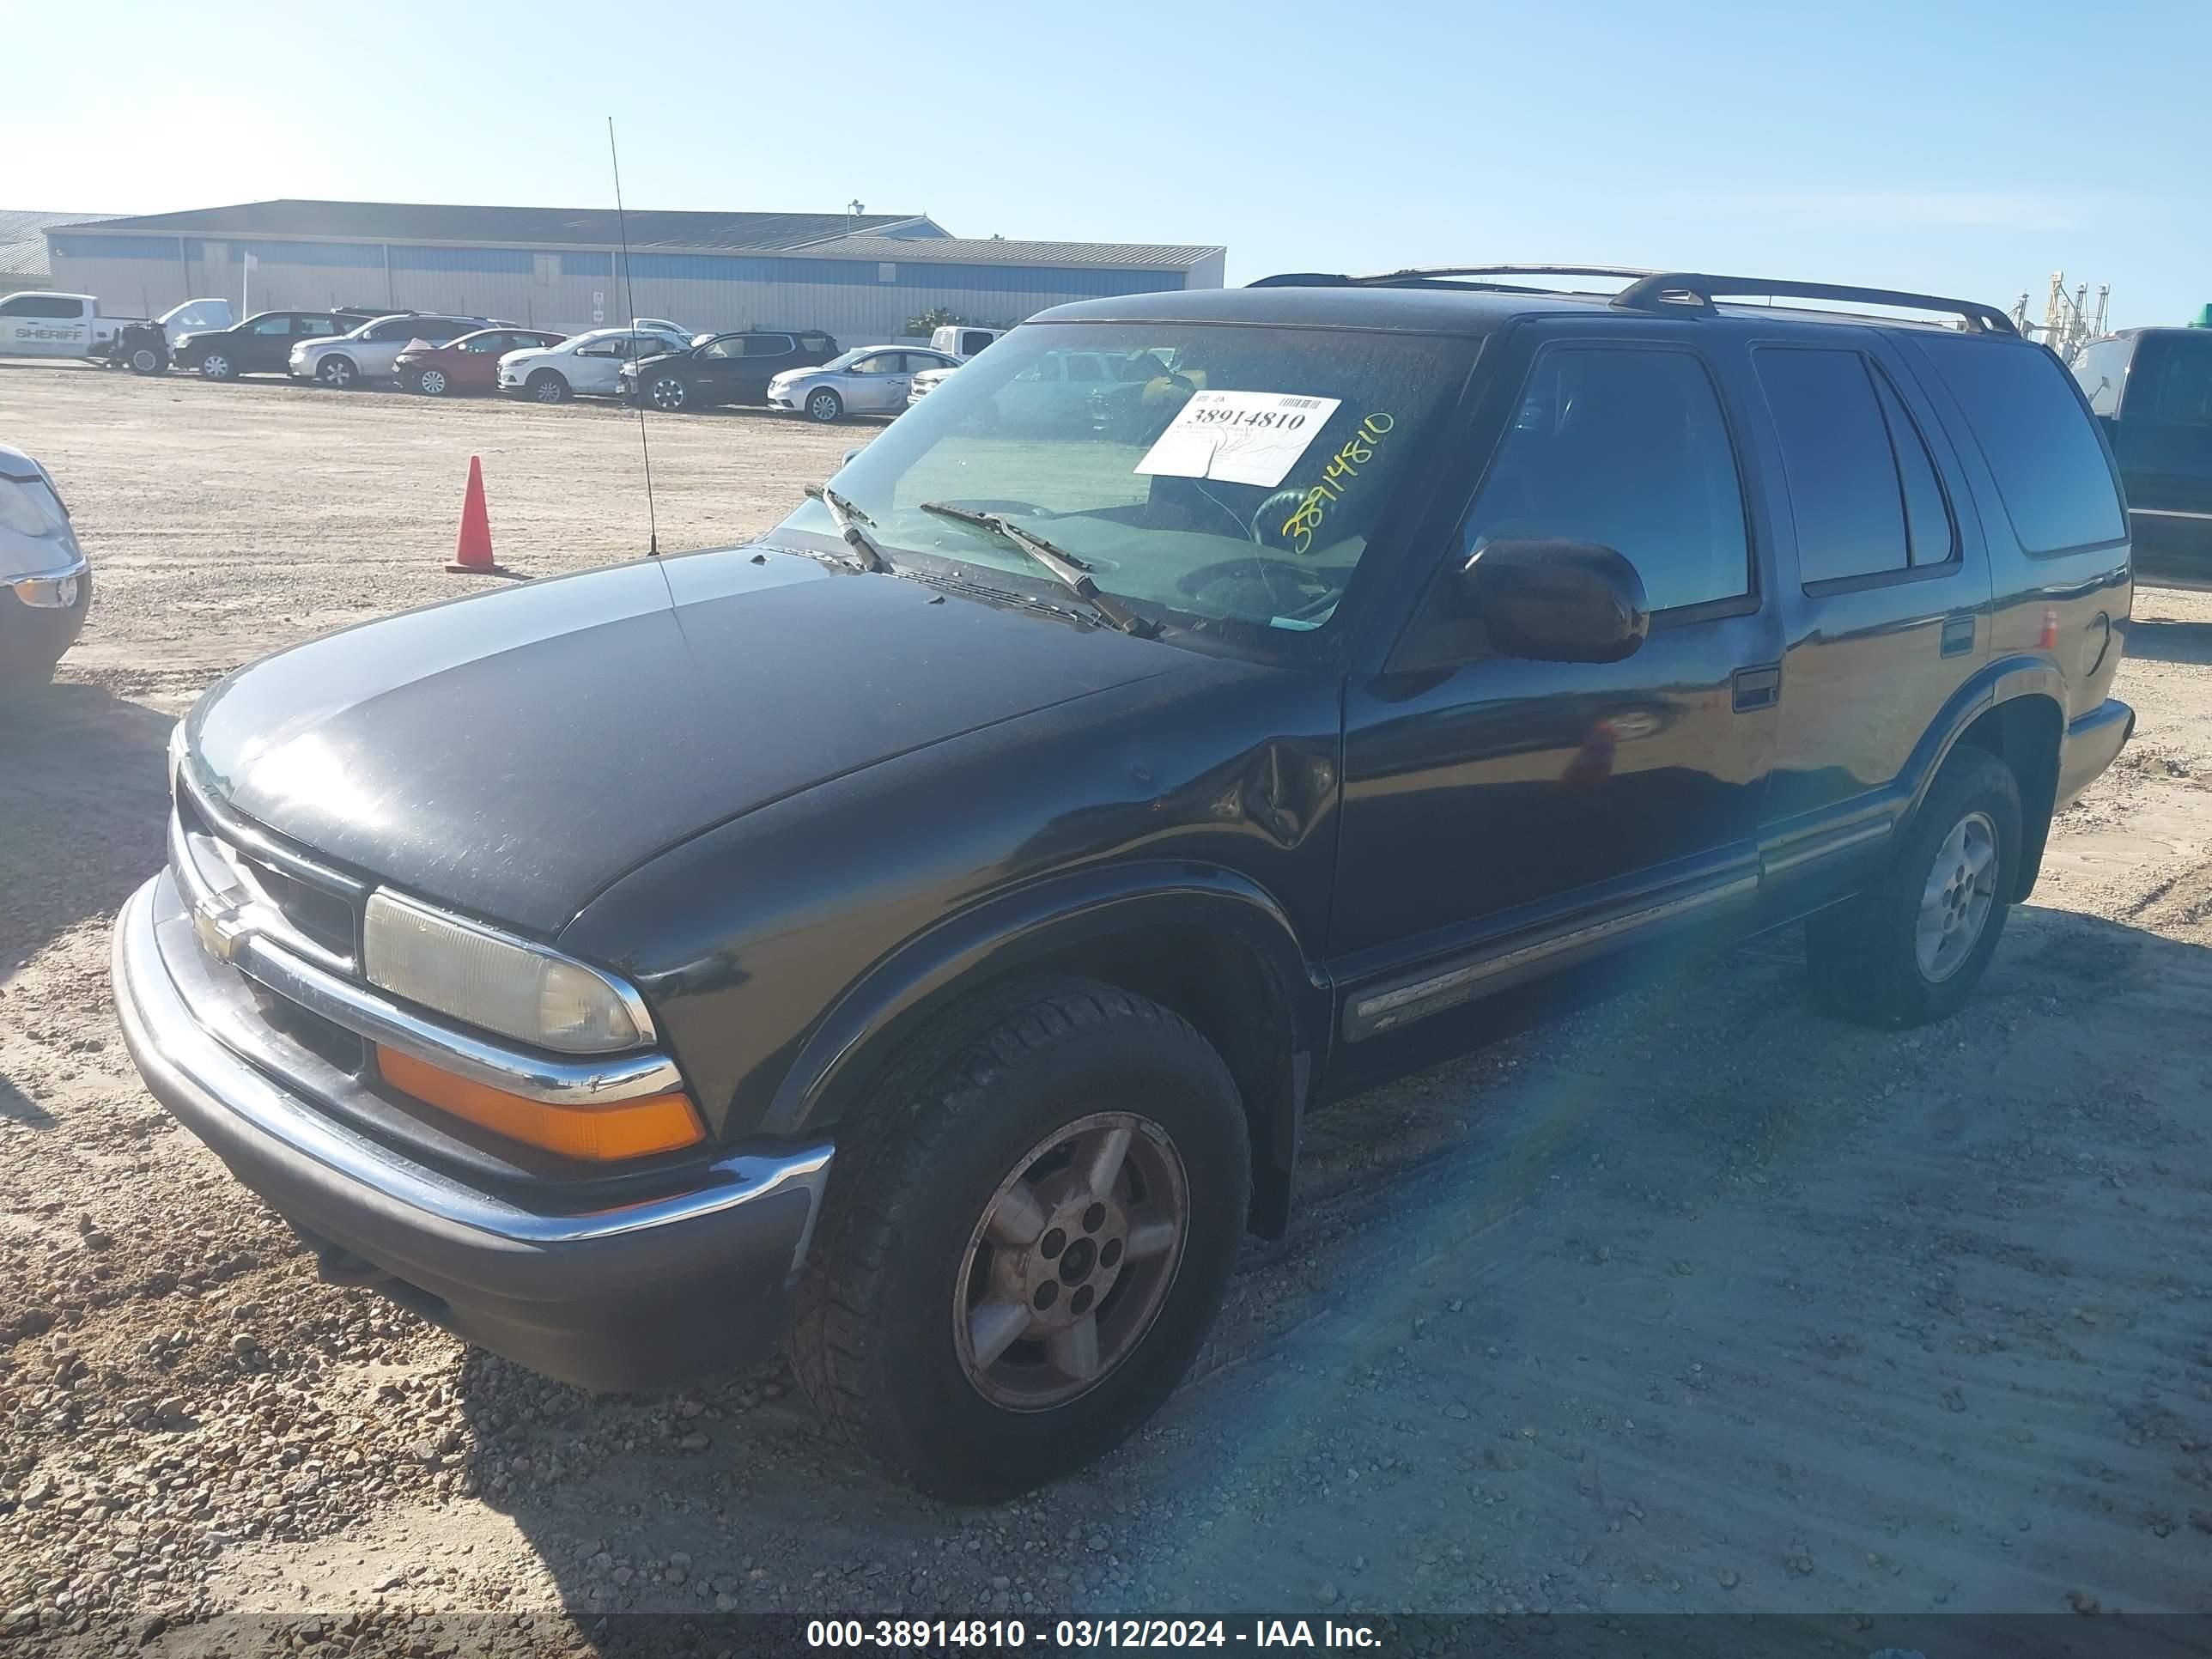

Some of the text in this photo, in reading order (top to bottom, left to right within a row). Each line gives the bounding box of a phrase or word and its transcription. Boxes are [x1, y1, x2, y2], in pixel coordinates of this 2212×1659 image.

[15, 328, 82, 340] SHERIFF
[1187, 409, 1306, 430] 38914810
[1282, 412, 1395, 555] 38914810
